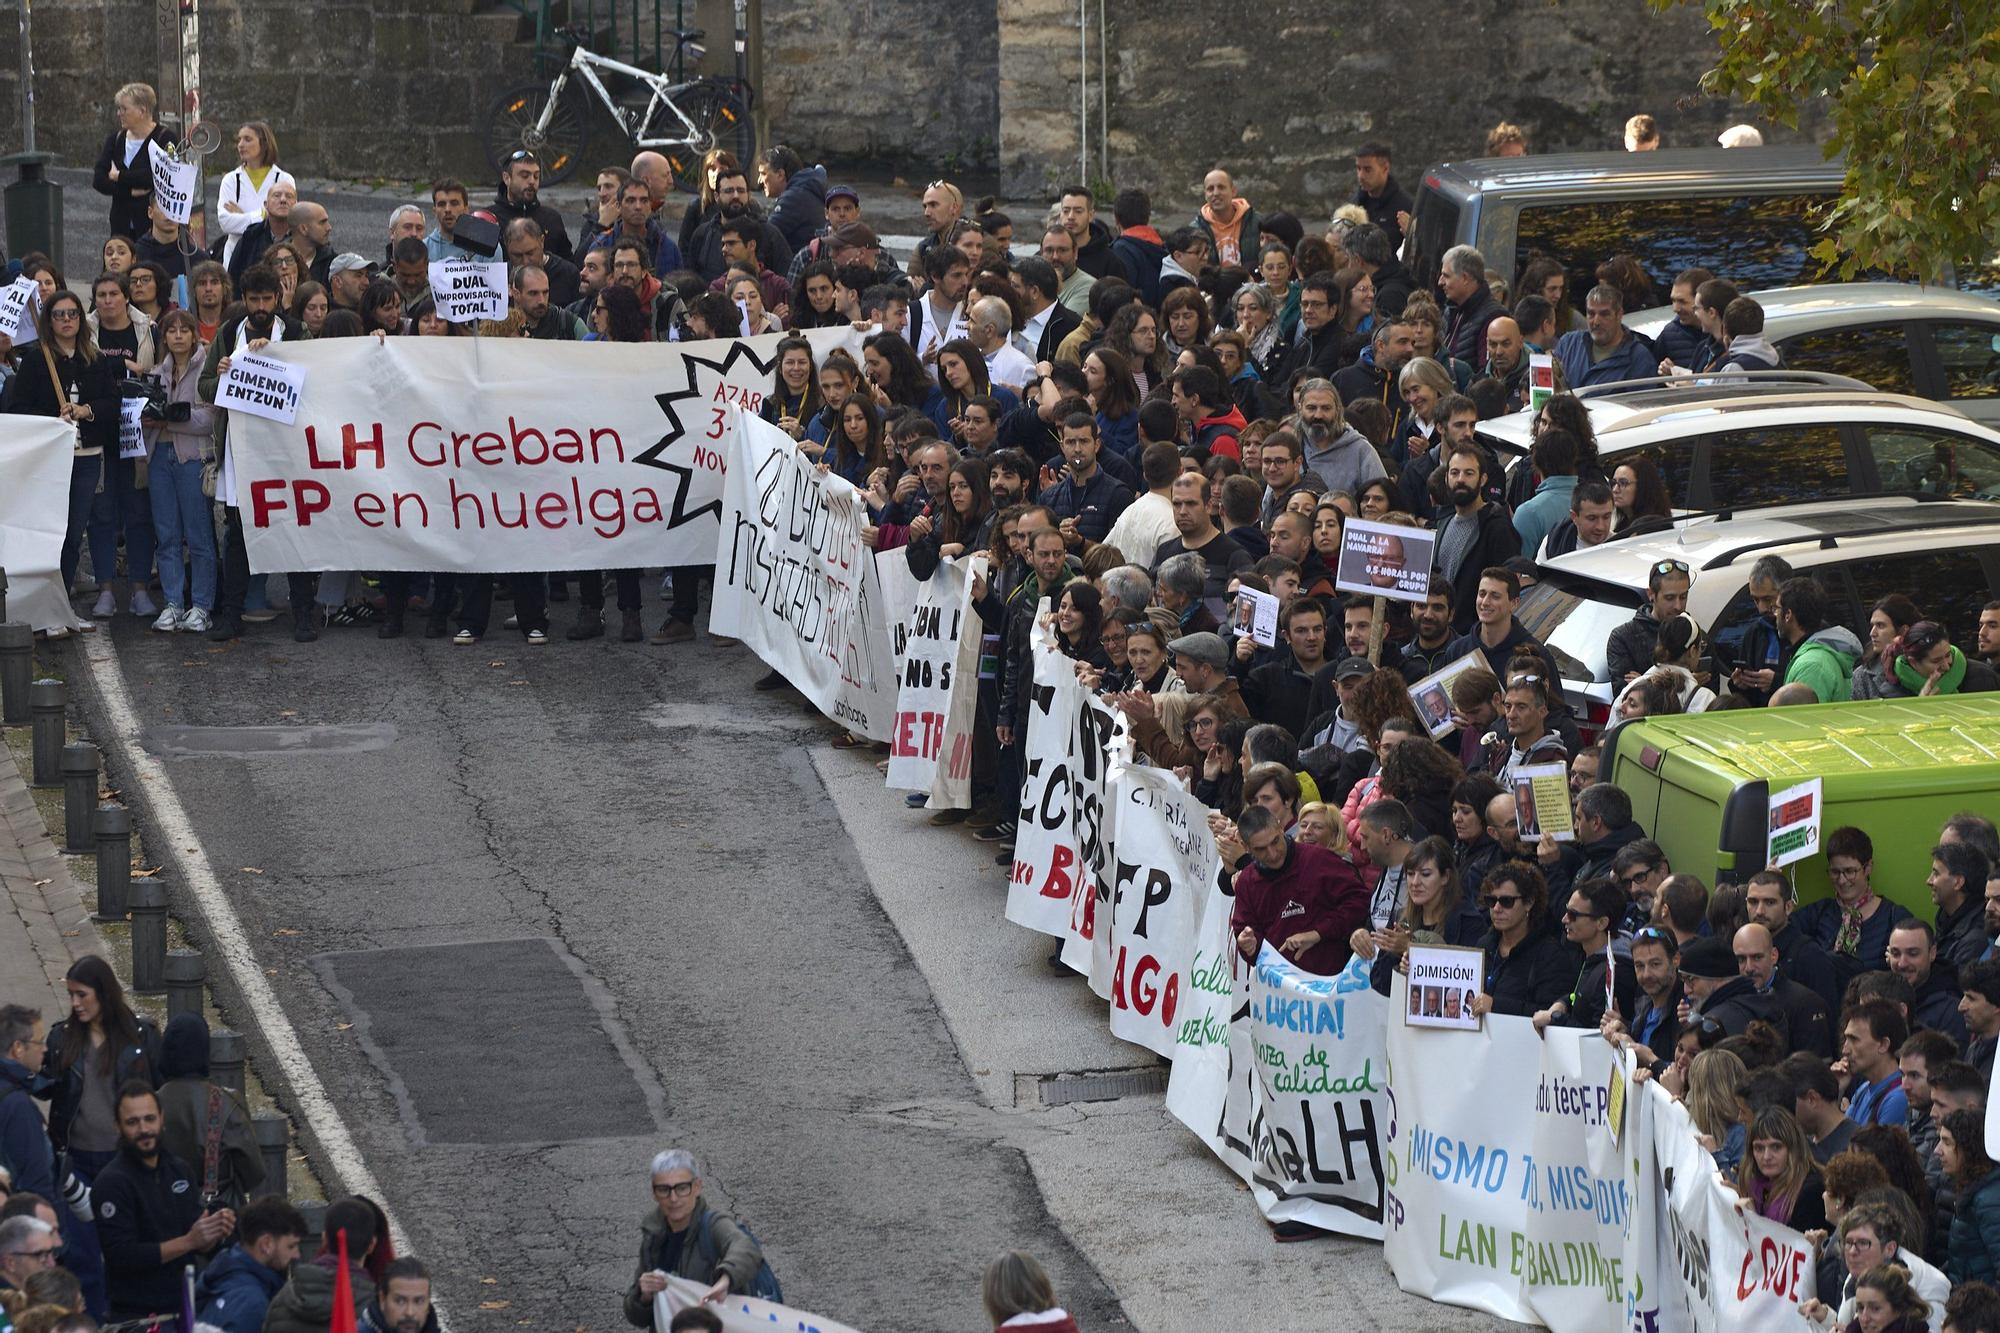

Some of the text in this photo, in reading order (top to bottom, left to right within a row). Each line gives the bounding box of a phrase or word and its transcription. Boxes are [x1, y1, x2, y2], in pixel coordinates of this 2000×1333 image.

[155, 163, 174, 188] DUAL
[452, 275, 488, 289] DUAL
[451, 302, 488, 316] TOTAL
[230, 368, 287, 394] GIMENO
[713, 381, 762, 413] AZAR
[305, 416, 625, 469] LH Greban
[250, 476, 664, 539] FP en huelga
[1347, 532, 1390, 547] DUAL A LA
[1381, 567, 1408, 579] HORAS
[1410, 571, 1428, 582] POR
[1398, 580, 1427, 592] GRUPO
[905, 658, 933, 689] NO
[1413, 963, 1474, 982] ¡DIMISIÓN!
[1265, 994, 1345, 1041] LUCHA!
[1302, 1043, 1330, 1068] de
[1273, 1058, 1379, 1095] calidad
[1407, 1123, 1509, 1193] ¡MISMO
[1439, 1212, 1497, 1269] LAN
